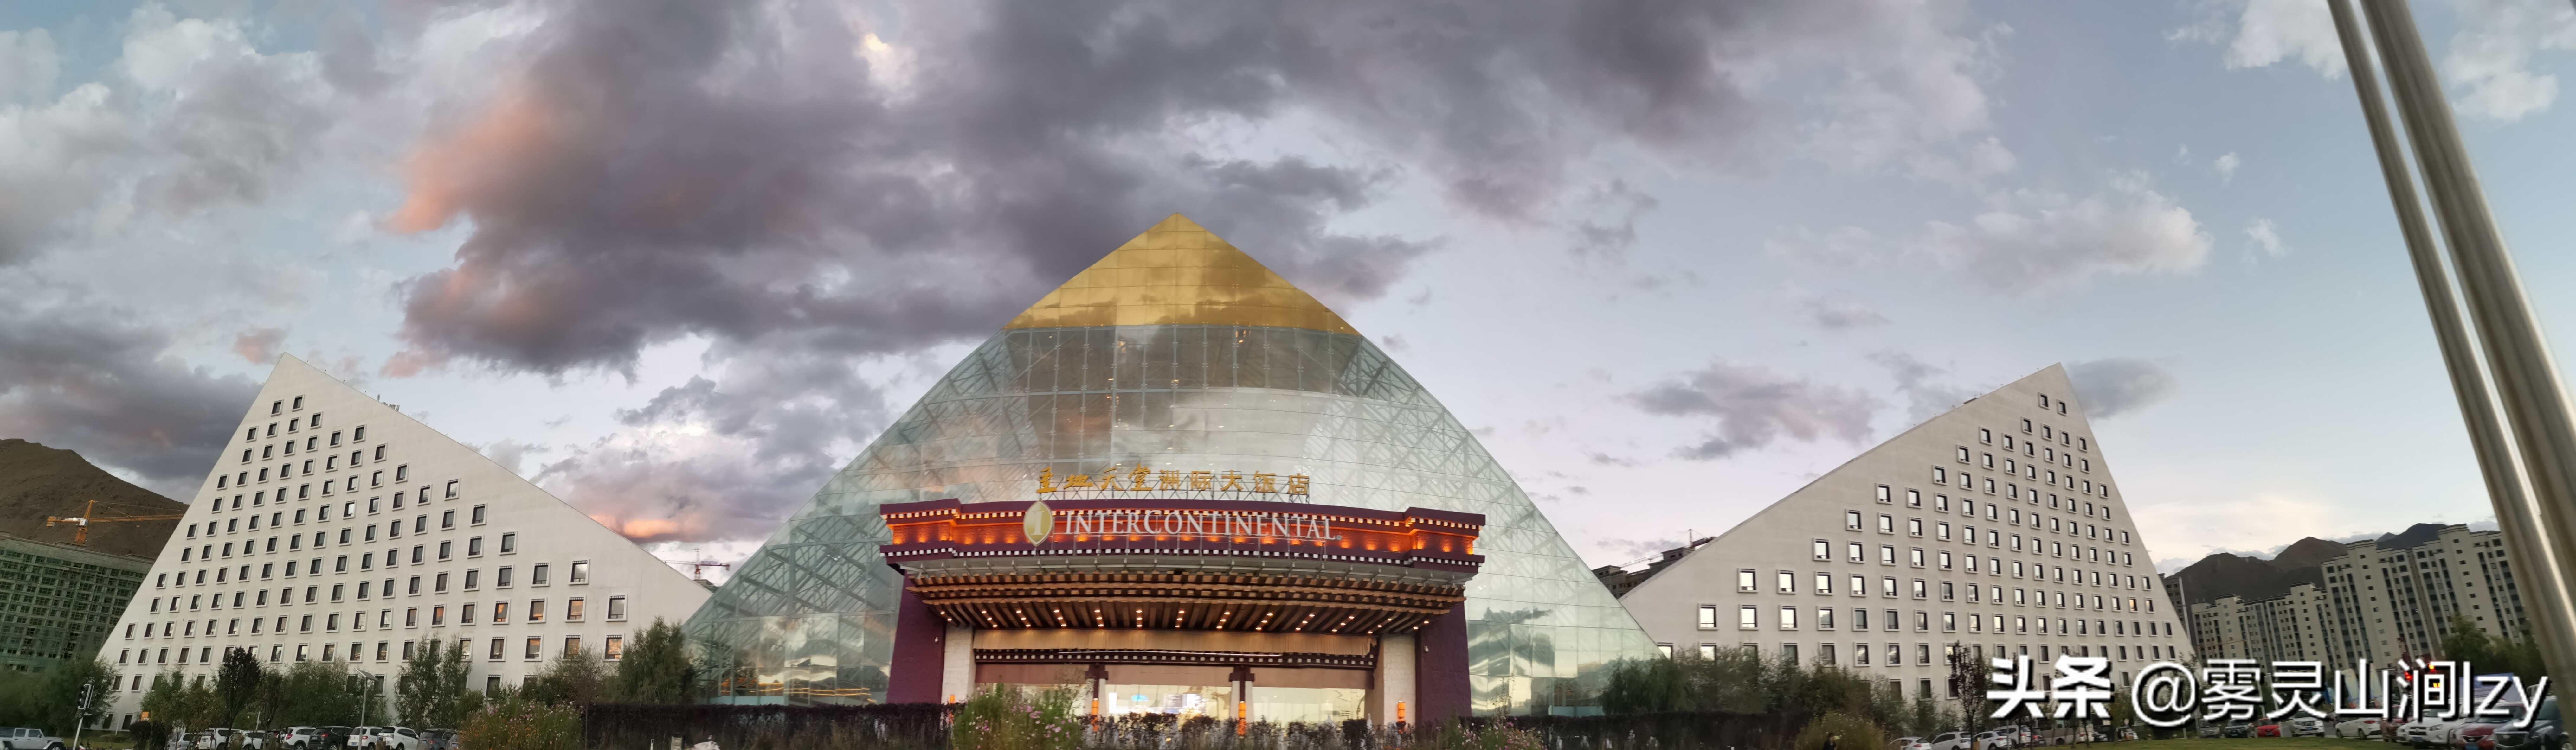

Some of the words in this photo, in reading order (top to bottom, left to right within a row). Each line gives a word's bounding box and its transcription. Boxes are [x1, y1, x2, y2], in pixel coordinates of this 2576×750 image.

[1036, 463, 1309, 494] 圣地天堂洲际大饭店
[1065, 510, 1336, 540] INTERCONTINENTAL
